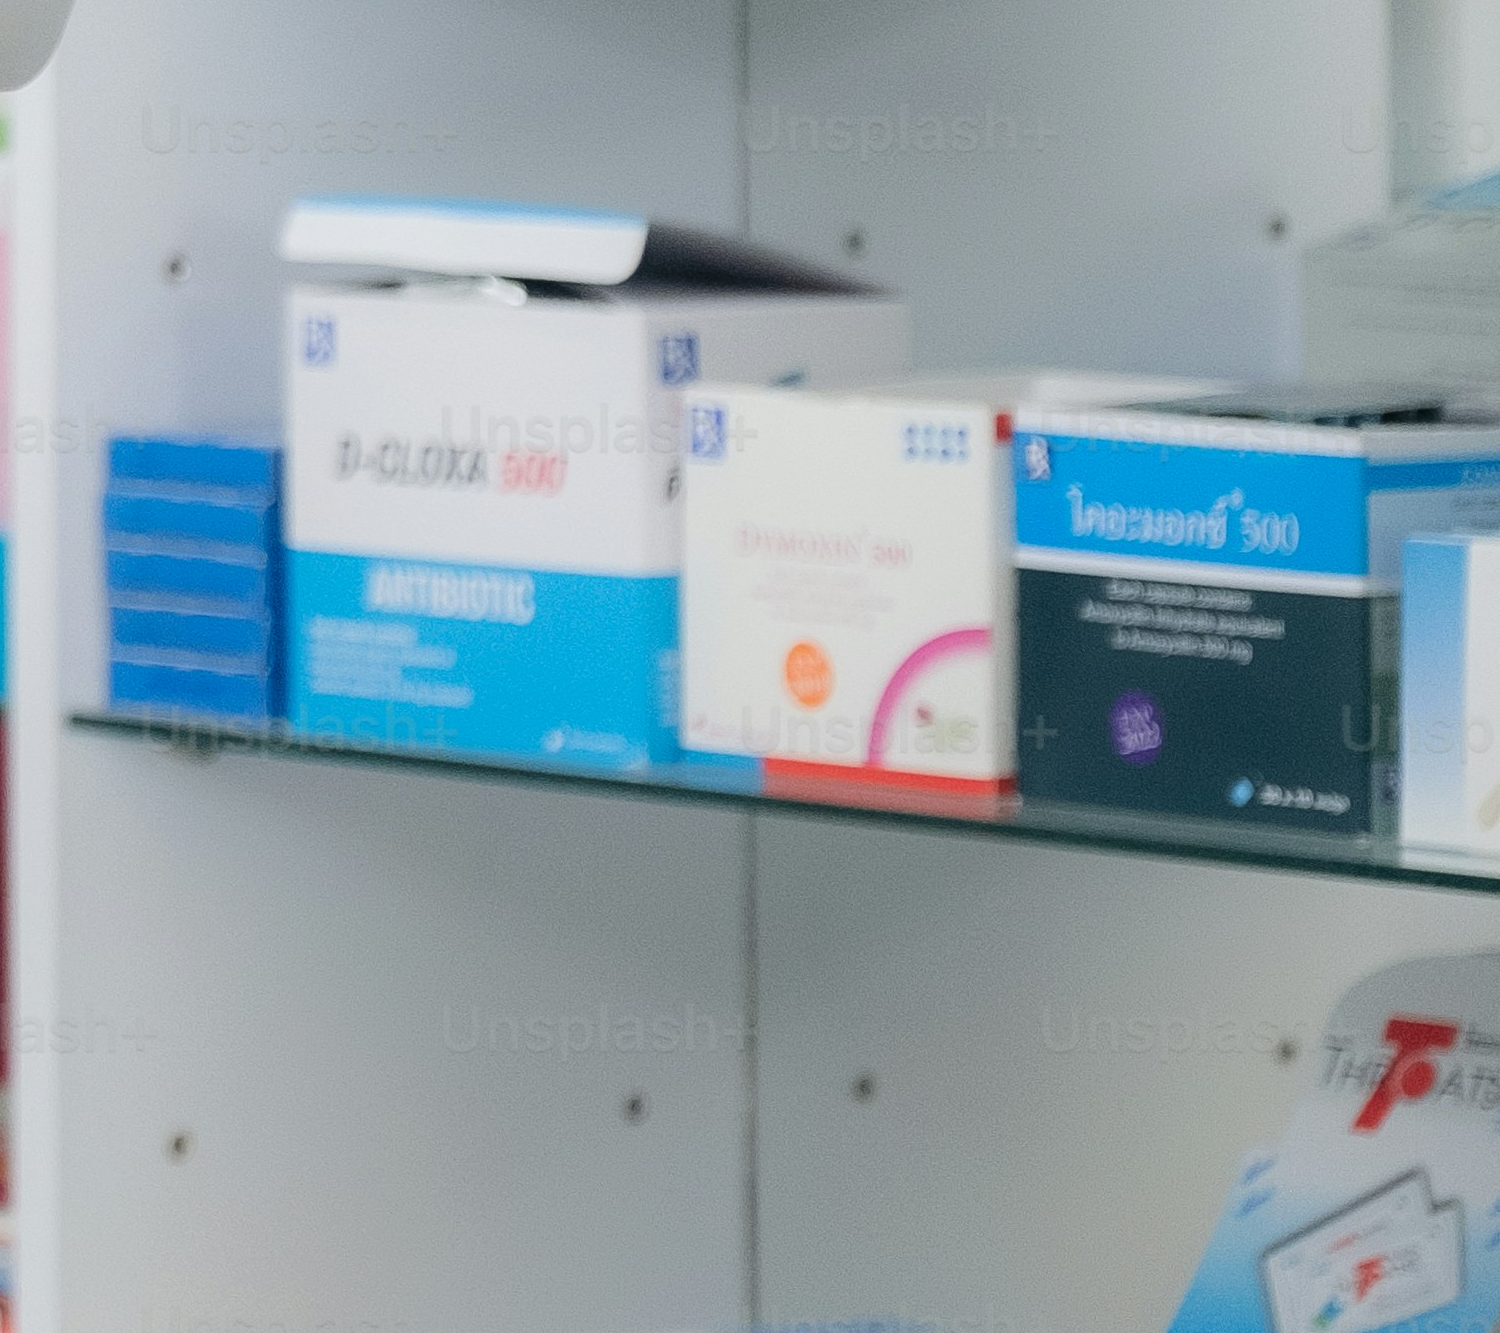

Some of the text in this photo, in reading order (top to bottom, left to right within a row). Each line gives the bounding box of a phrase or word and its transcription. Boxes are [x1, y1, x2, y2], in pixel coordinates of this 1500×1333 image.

[335, 433, 567, 495] D-CLOXA 500
[1241, 507, 1300, 556] 500
[366, 565, 536, 626] ANTIBIOTIC
